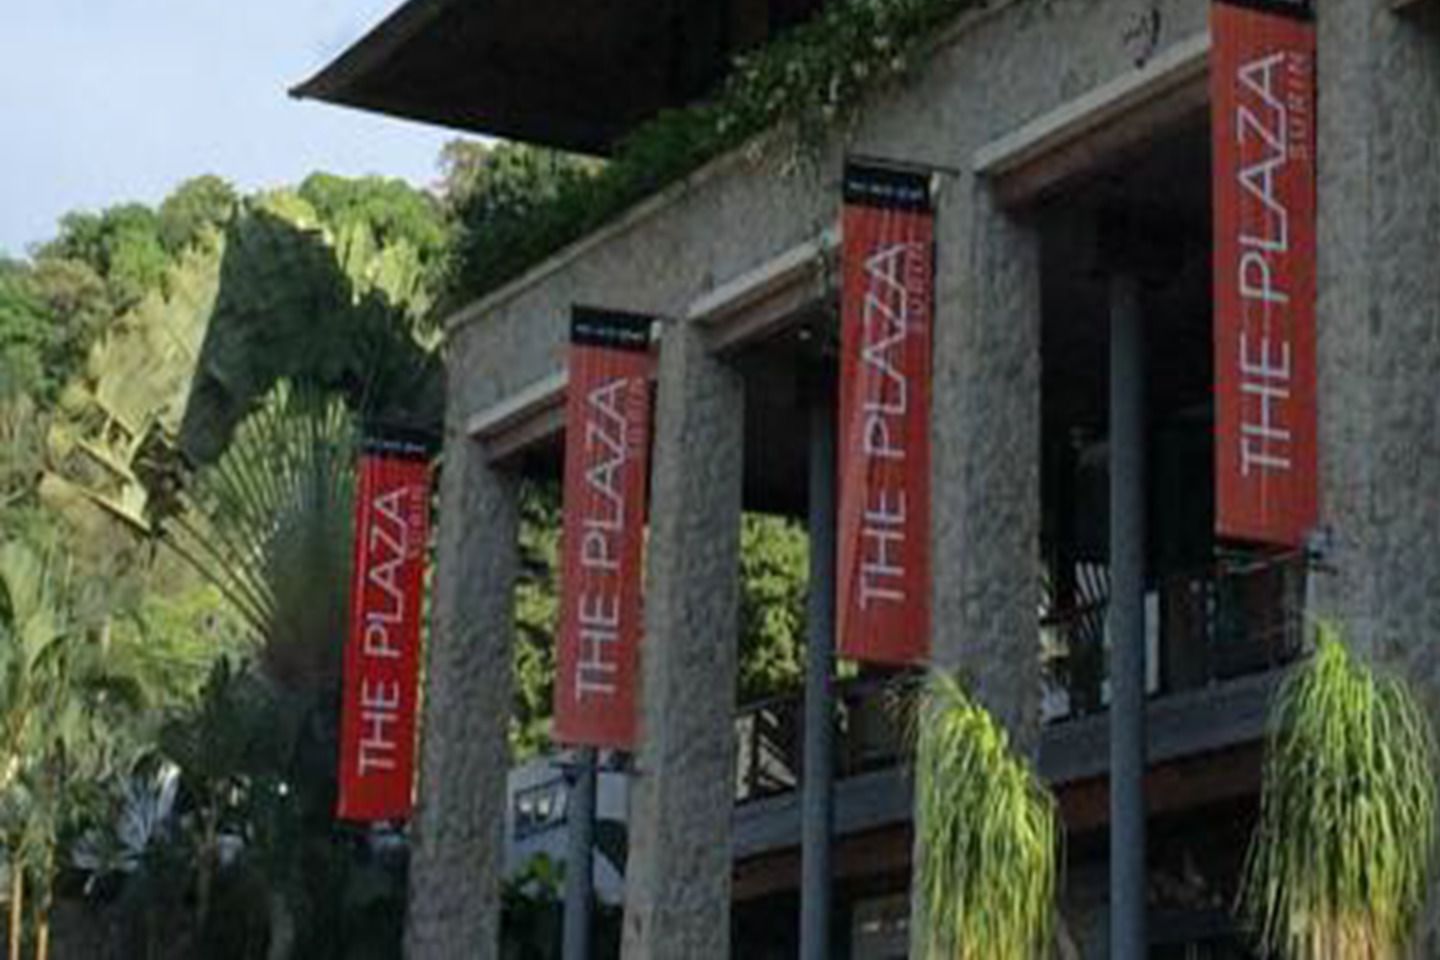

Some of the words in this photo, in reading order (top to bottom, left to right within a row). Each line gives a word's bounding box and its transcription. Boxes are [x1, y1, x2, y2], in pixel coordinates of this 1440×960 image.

[1238, 51, 1290, 302] PLAZA
[862, 243, 907, 458] PLAZA
[1238, 333, 1291, 477] THE
[580, 378, 628, 570] PLAZA
[858, 490, 906, 611] THE
[363, 487, 409, 657] PLAZA
[575, 593, 619, 701] THE
[357, 676, 400, 776] THE
